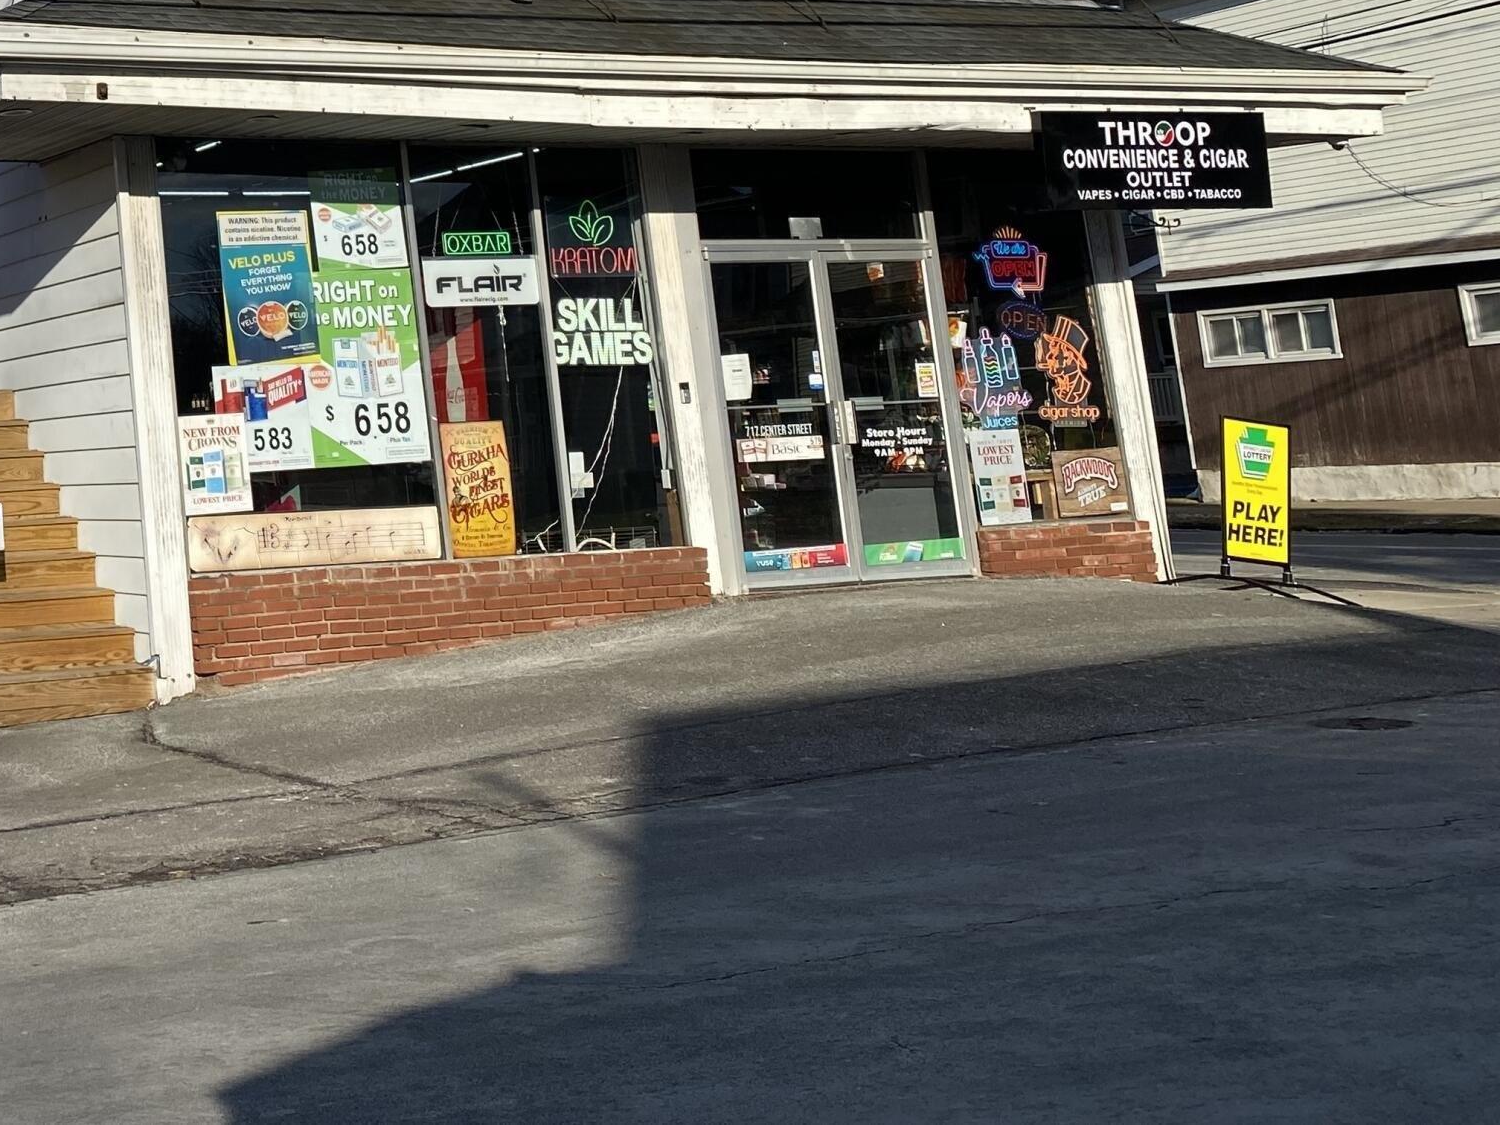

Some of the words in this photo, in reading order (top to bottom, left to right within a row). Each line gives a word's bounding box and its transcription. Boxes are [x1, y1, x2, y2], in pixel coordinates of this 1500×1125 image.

[1063, 149, 1178, 169] CONVENIENCE
[1183, 149, 1195, 168] &
[1199, 149, 1249, 169] CIGAR
[1126, 171, 1192, 187] OUTLET
[1077, 190, 1112, 200] VAPES
[1122, 190, 1155, 200] CIGAR
[1163, 189, 1185, 199] CBD
[1194, 188, 1242, 199] TABACCO
[261, 216, 273, 224] This
[274, 216, 297, 225] product
[447, 235, 508, 252] OXBAR
[228, 256, 260, 270] VELO
[263, 250, 296, 265] PLUS
[551, 247, 638, 274] KRATOM
[248, 265, 282, 276] FORGET
[992, 261, 1036, 277] OPEN
[240, 273, 293, 287] EVERYTHING
[436, 274, 523, 294] FLAIR
[245, 285, 264, 296] YOU
[265, 282, 292, 293] KNOW
[312, 280, 375, 304] RIGHT
[378, 285, 398, 298] on
[260, 312, 286, 322] VELO
[289, 312, 306, 320] VELO
[333, 304, 412, 329] MONEY
[557, 298, 644, 331] SKILL
[1001, 310, 1047, 332] OPEN
[552, 331, 653, 365] GAMES
[960, 388, 1032, 417] Vapors
[326, 404, 335, 423] $
[1040, 407, 1068, 421] cigar
[1071, 405, 1100, 423] shop
[761, 425, 786, 436] CENTER
[787, 423, 812, 435] STREET
[984, 416, 1018, 429] Juices
[183, 428, 207, 439] NEW
[211, 426, 240, 436] FROM
[254, 427, 292, 451] 583
[866, 428, 894, 437] Store
[896, 426, 927, 437] Hours
[188, 437, 237, 451] CROWNS
[772, 443, 802, 455] Basic
[862, 438, 895, 447] Monday
[902, 436, 933, 446] Sunday
[977, 445, 1015, 455] LOWEST
[447, 444, 510, 475] GURKHA
[983, 456, 1012, 465] PRICE
[1243, 451, 1271, 461] LOTTERY
[1062, 457, 1118, 494] BACKWOODS
[469, 477, 505, 499] FINEST
[1078, 485, 1107, 507] TRUE
[193, 497, 221, 505] LOWEST
[222, 495, 243, 503] PRICE
[450, 493, 510, 525] CIGARS
[1232, 500, 1282, 523] PLAY
[1228, 523, 1284, 547] HERE!
